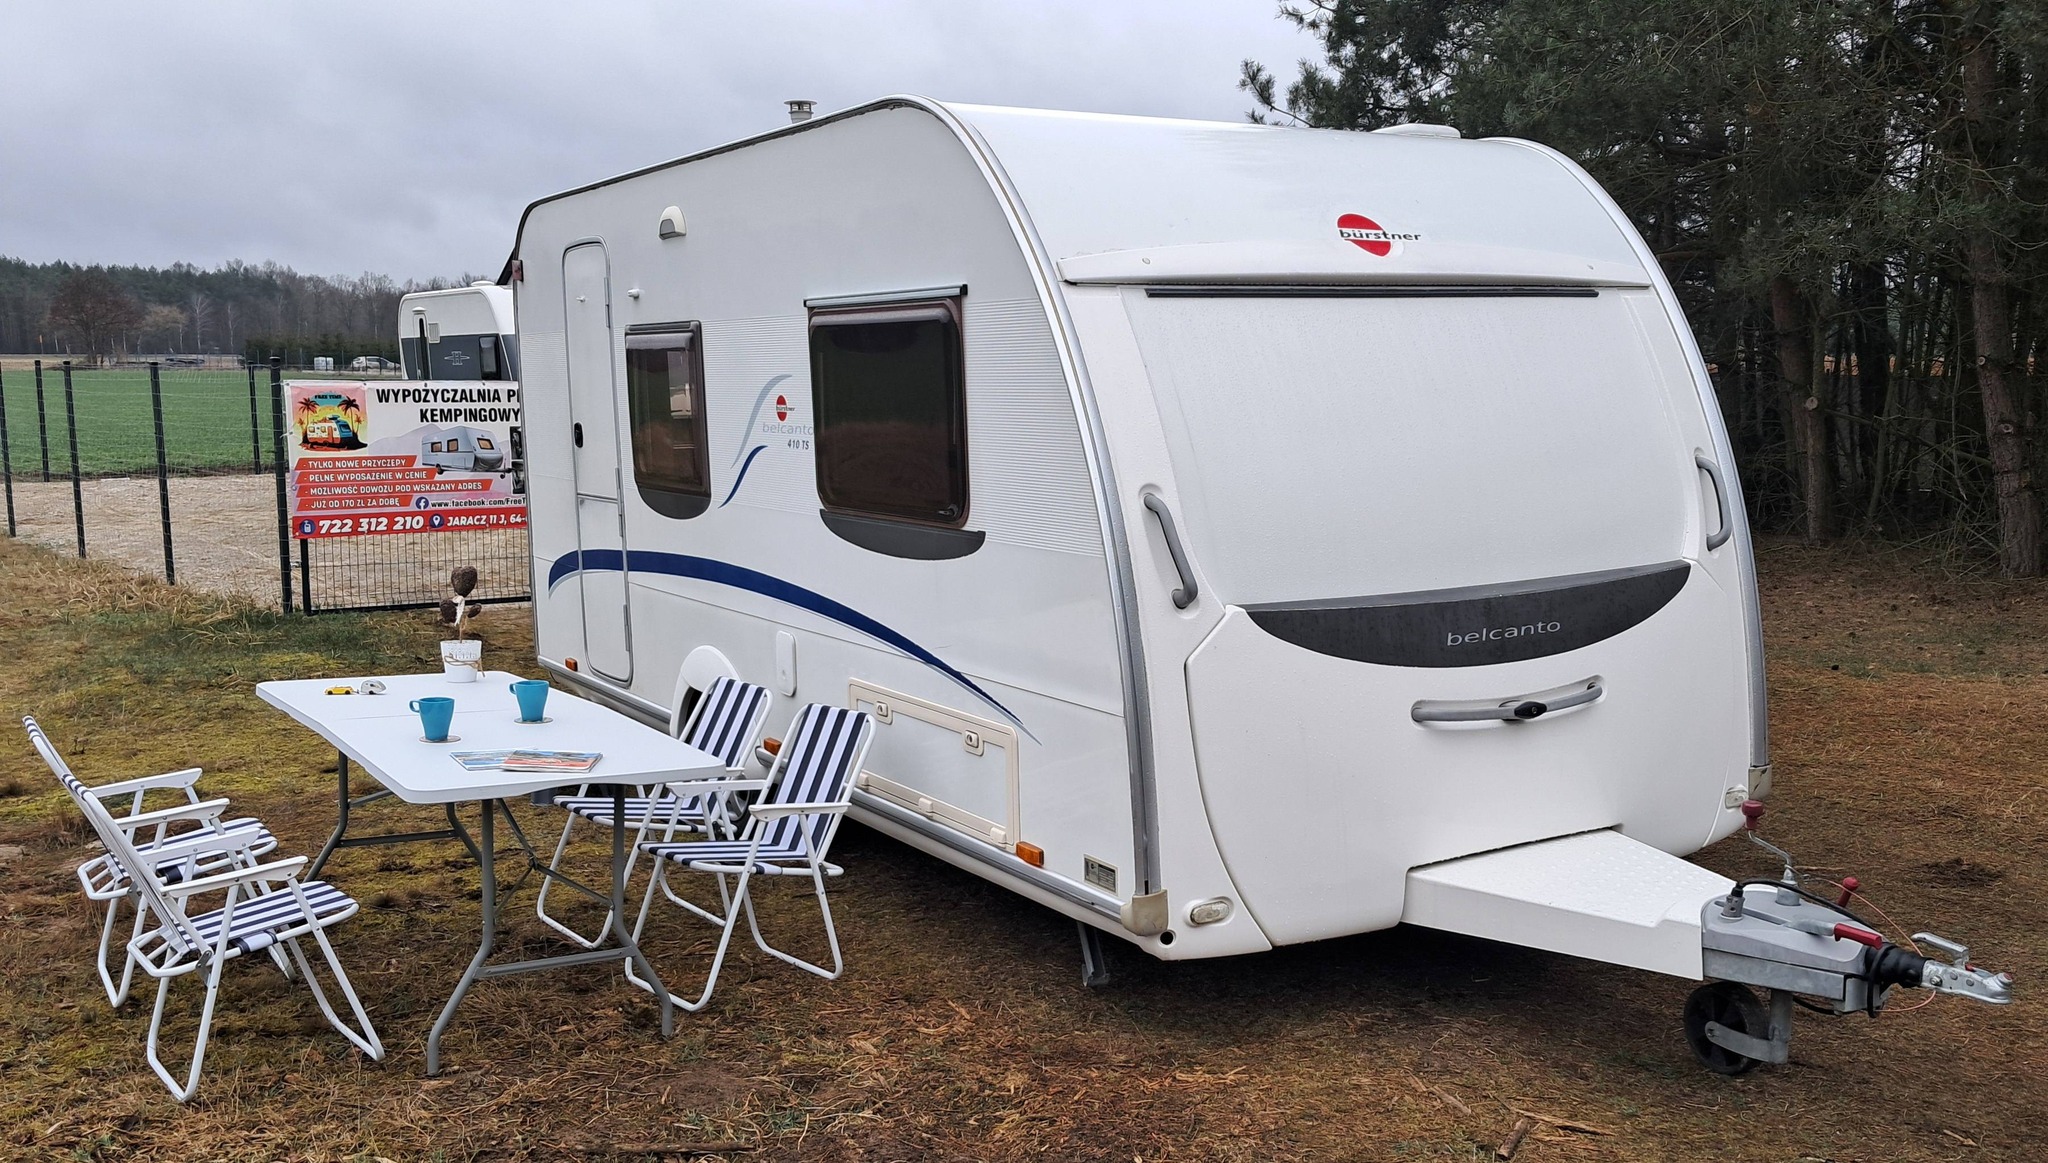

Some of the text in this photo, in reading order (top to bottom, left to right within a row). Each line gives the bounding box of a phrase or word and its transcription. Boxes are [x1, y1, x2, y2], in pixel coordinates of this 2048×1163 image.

[1339, 229, 1421, 240] bürstner
[787, 439, 810, 450] 410 TS
[308, 458, 406, 469] TYLKO NOWE PRZYCZEPY
[395, 471, 403, 479] W
[405, 471, 427, 479] CENIE
[360, 484, 393, 494] DOWOZU
[395, 484, 411, 492] POD
[413, 483, 456, 491] WSKAZANY
[458, 482, 482, 490] ADRES
[328, 500, 340, 508] OD
[342, 499, 355, 507] 170
[367, 498, 377, 506] ZA
[318, 515, 424, 534] 722 312 210
[447, 515, 487, 526] JARACZ
[489, 514, 497, 524] 11
[1447, 621, 1561, 646] belcanto
